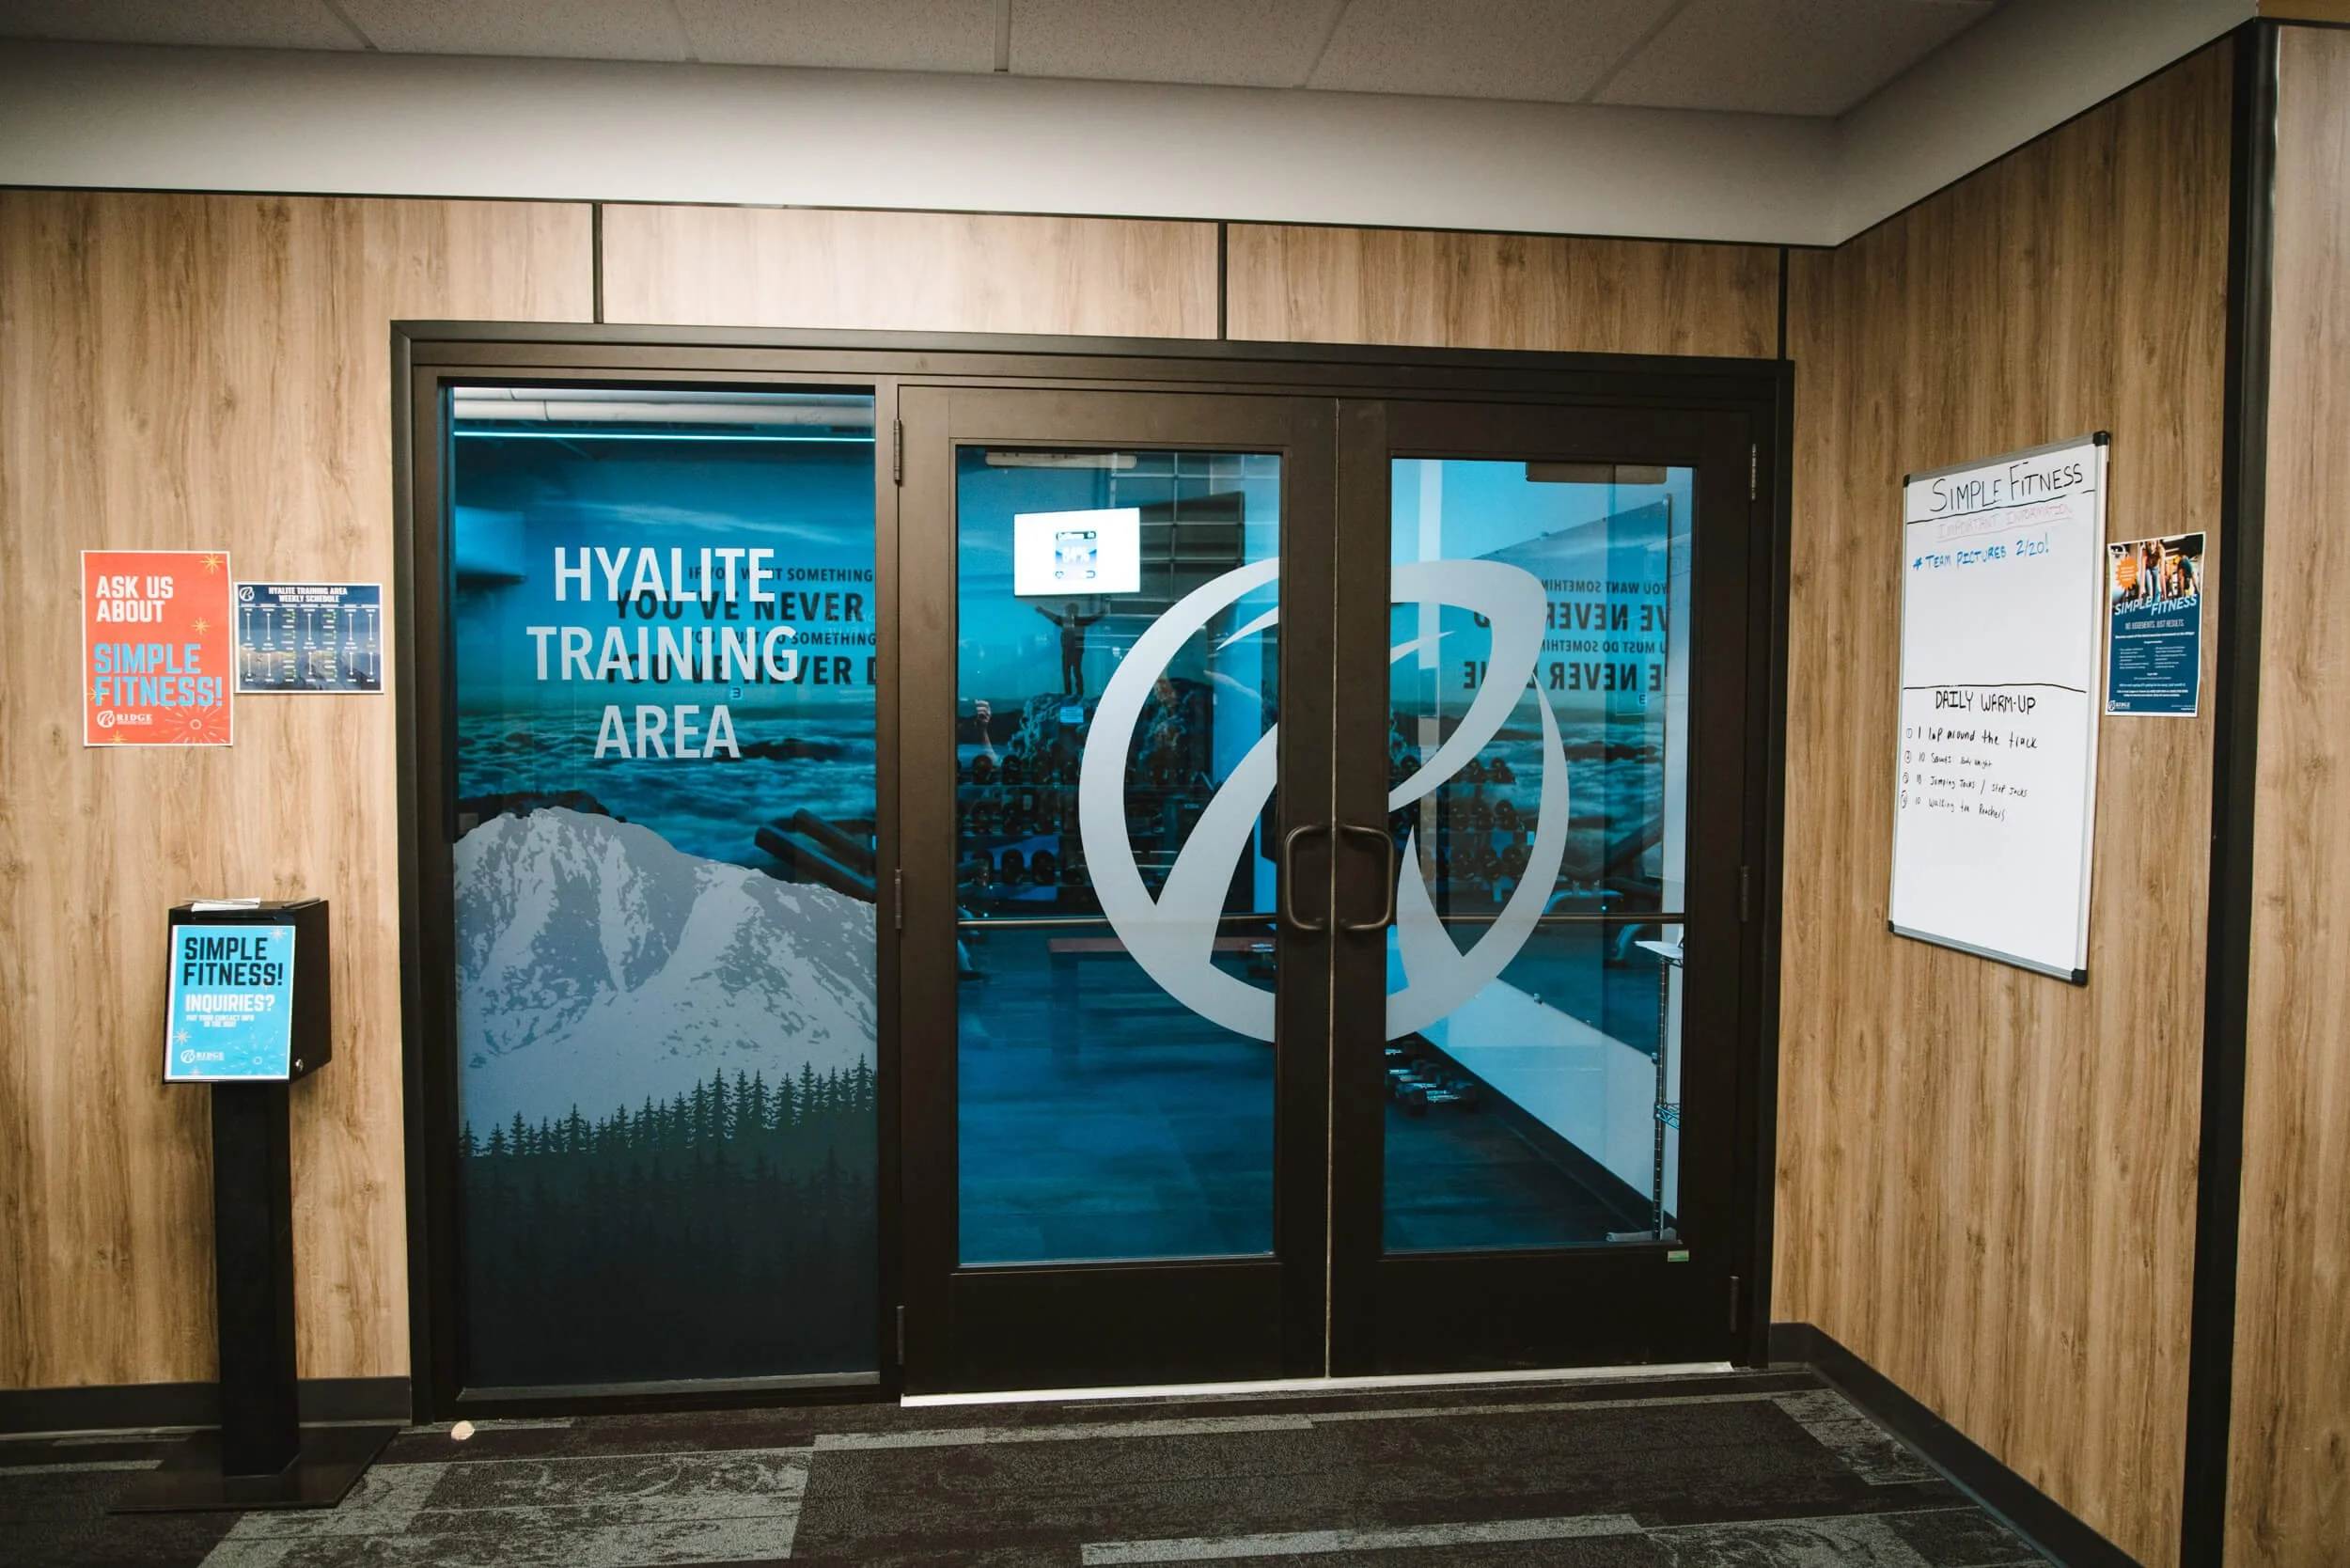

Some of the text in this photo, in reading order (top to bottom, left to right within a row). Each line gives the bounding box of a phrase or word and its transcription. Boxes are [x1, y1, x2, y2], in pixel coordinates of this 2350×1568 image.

[1930, 462, 2083, 512] SIMPLE FITNESS
[1925, 555, 1951, 569] TEAM
[1957, 545, 2007, 568] PICTURES
[2015, 533, 2049, 557] 2/20!
[555, 547, 775, 603] HYALITE
[788, 568, 873, 582] SOMETHING
[96, 575, 173, 599] ASK US
[268, 587, 348, 595] HYALITE TRAINING AREA
[96, 600, 164, 623] ABOUT
[754, 591, 864, 621] NEVER
[2114, 594, 2198, 616] SIMPLE FITNESS
[791, 632, 876, 646] SOMETHING
[95, 644, 201, 673] SIMPLE
[526, 625, 798, 681] TRAINING
[94, 676, 223, 706] FITNESS!
[1935, 690, 1974, 713] DAILY
[117, 713, 152, 722] RIDGE
[594, 704, 742, 759] AREA
[1947, 729, 1975, 742] around
[1982, 729, 2000, 745] the
[2009, 731, 2039, 749] track
[1930, 776, 1956, 790] Jumping
[185, 937, 268, 961] SIMPLE
[183, 963, 283, 986] FITNESS!
[185, 994, 275, 1013] INQUIRIES?
